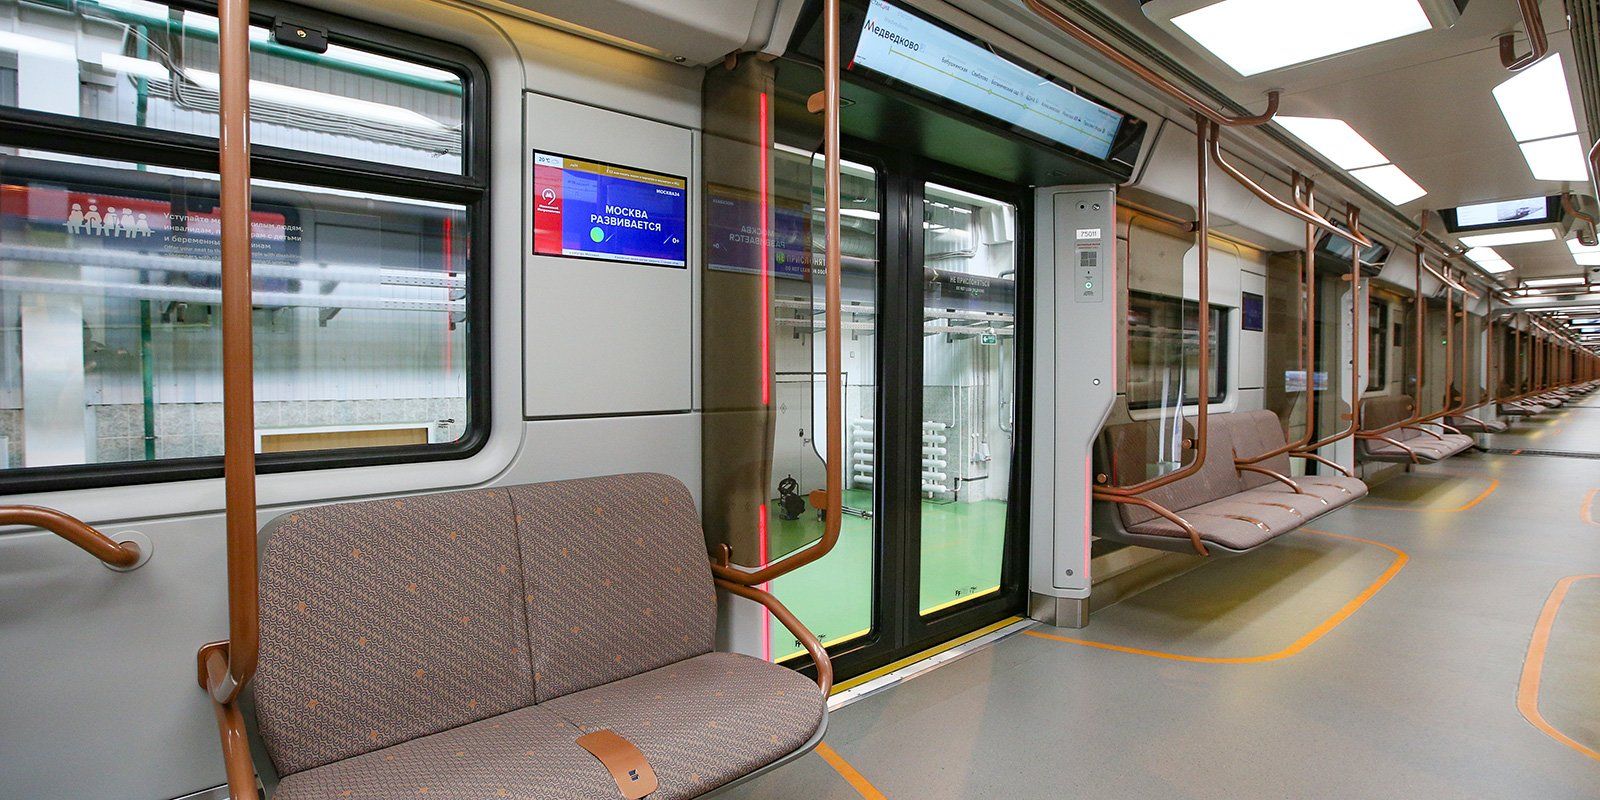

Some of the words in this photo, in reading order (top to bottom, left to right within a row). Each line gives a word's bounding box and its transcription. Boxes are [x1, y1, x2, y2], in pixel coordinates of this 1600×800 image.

[864, 19, 919, 51] Медведково
[656, 189, 680, 197] МОСКВА24
[605, 205, 648, 219] МОСКВА
[164, 212, 209, 222] Уступайте
[276, 224, 304, 232] людям,
[164, 225, 214, 235] инвалидам,
[590, 214, 661, 232] РАЗВИВАЕТСЯ
